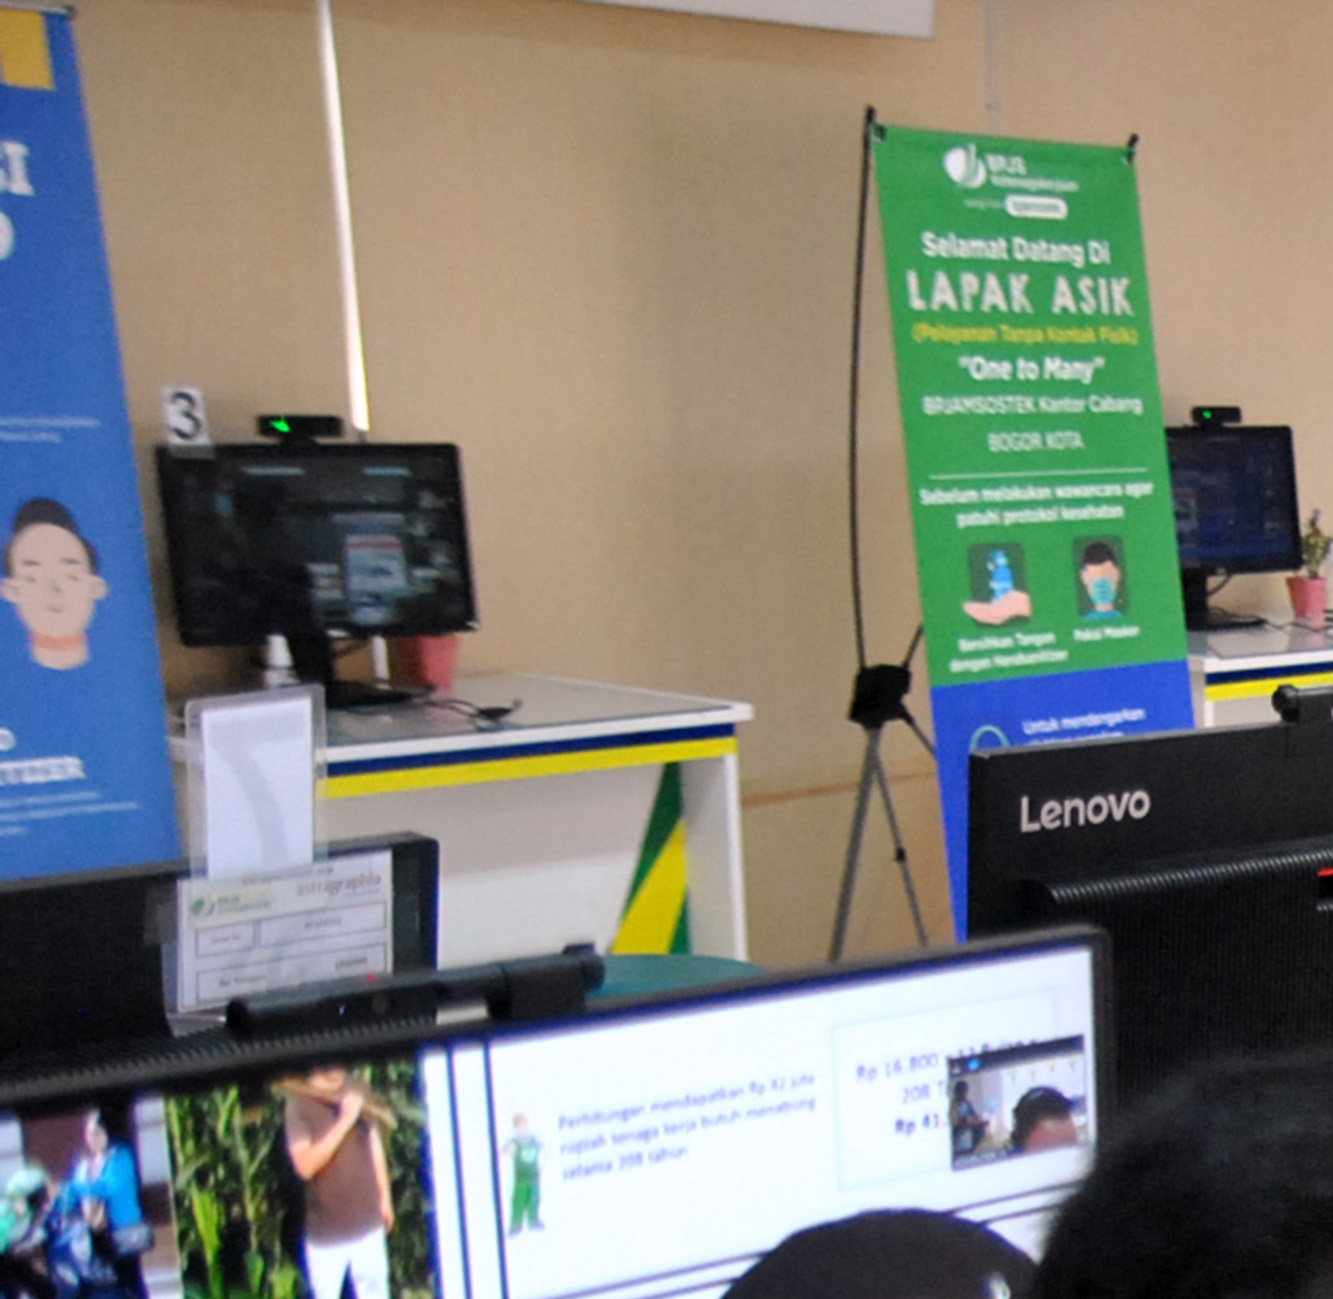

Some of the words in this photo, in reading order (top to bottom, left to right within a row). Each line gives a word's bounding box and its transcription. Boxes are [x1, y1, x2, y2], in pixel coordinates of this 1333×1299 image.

[922, 231, 1009, 261] Selamat
[1012, 235, 1084, 268] Datang
[1089, 239, 1110, 265] Di
[906, 269, 1033, 313] LAPAK
[1052, 275, 1135, 316] ASIK
[1016, 357, 1040, 380] to
[170, 391, 201, 440] 3
[1020, 790, 1152, 834] Lenovo
